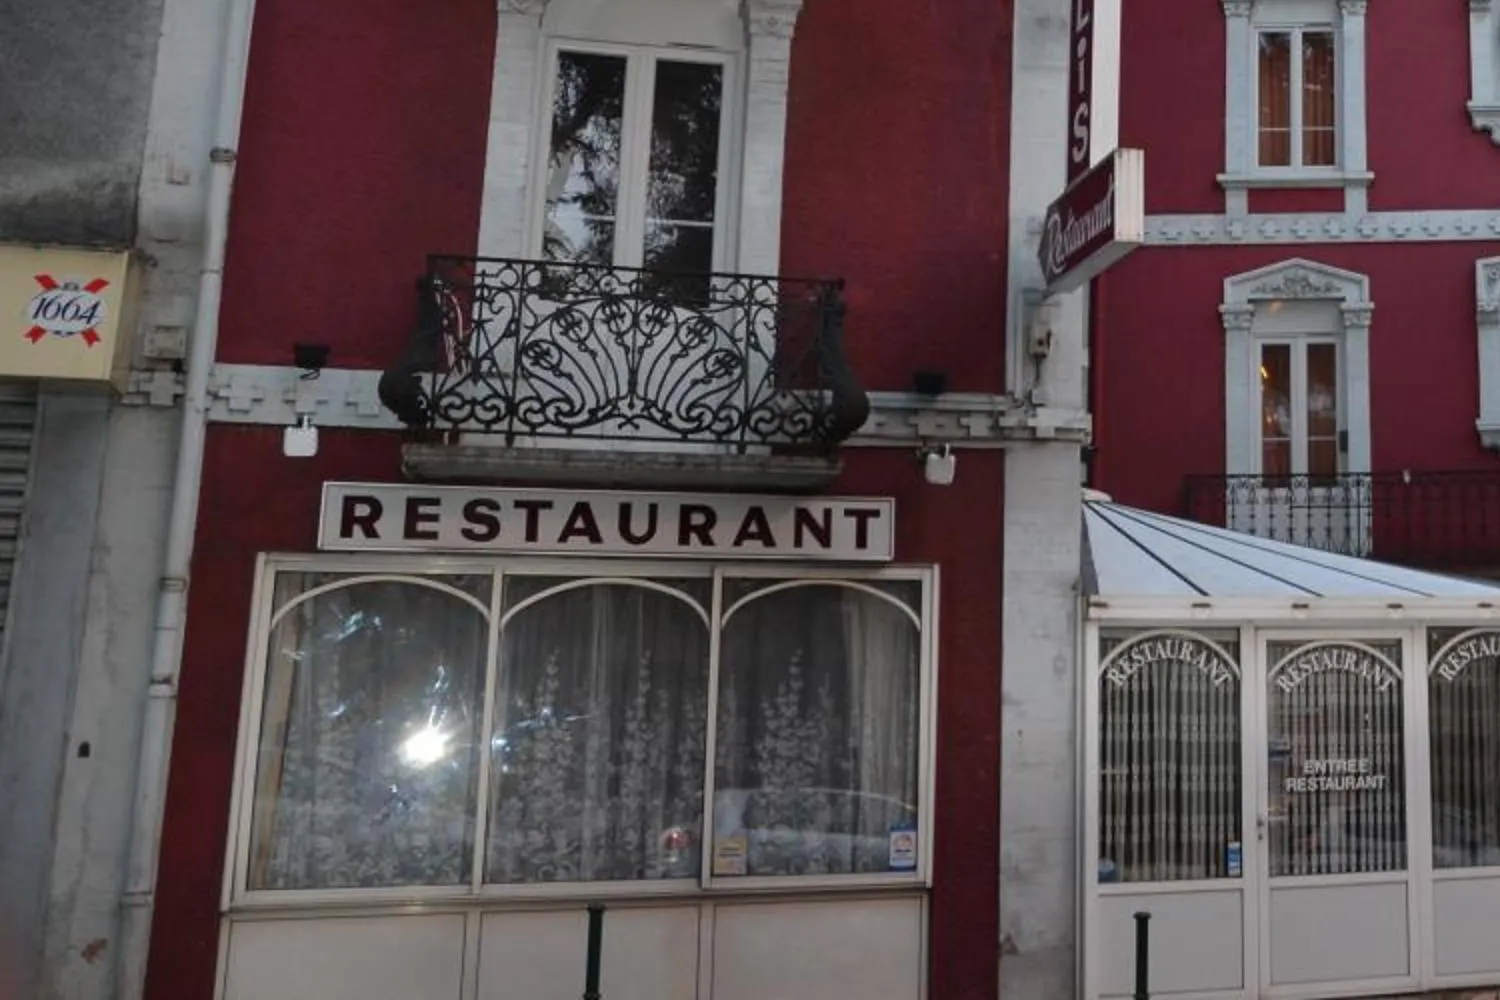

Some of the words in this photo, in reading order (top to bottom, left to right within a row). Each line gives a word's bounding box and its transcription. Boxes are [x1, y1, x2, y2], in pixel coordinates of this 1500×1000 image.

[31, 294, 103, 325] 1664
[339, 494, 881, 549] RESTAURANT
[1106, 639, 1234, 687] RESTAURANT
[1276, 648, 1397, 693] RESTAURANT
[1285, 774, 1386, 792] RESTAURANT
